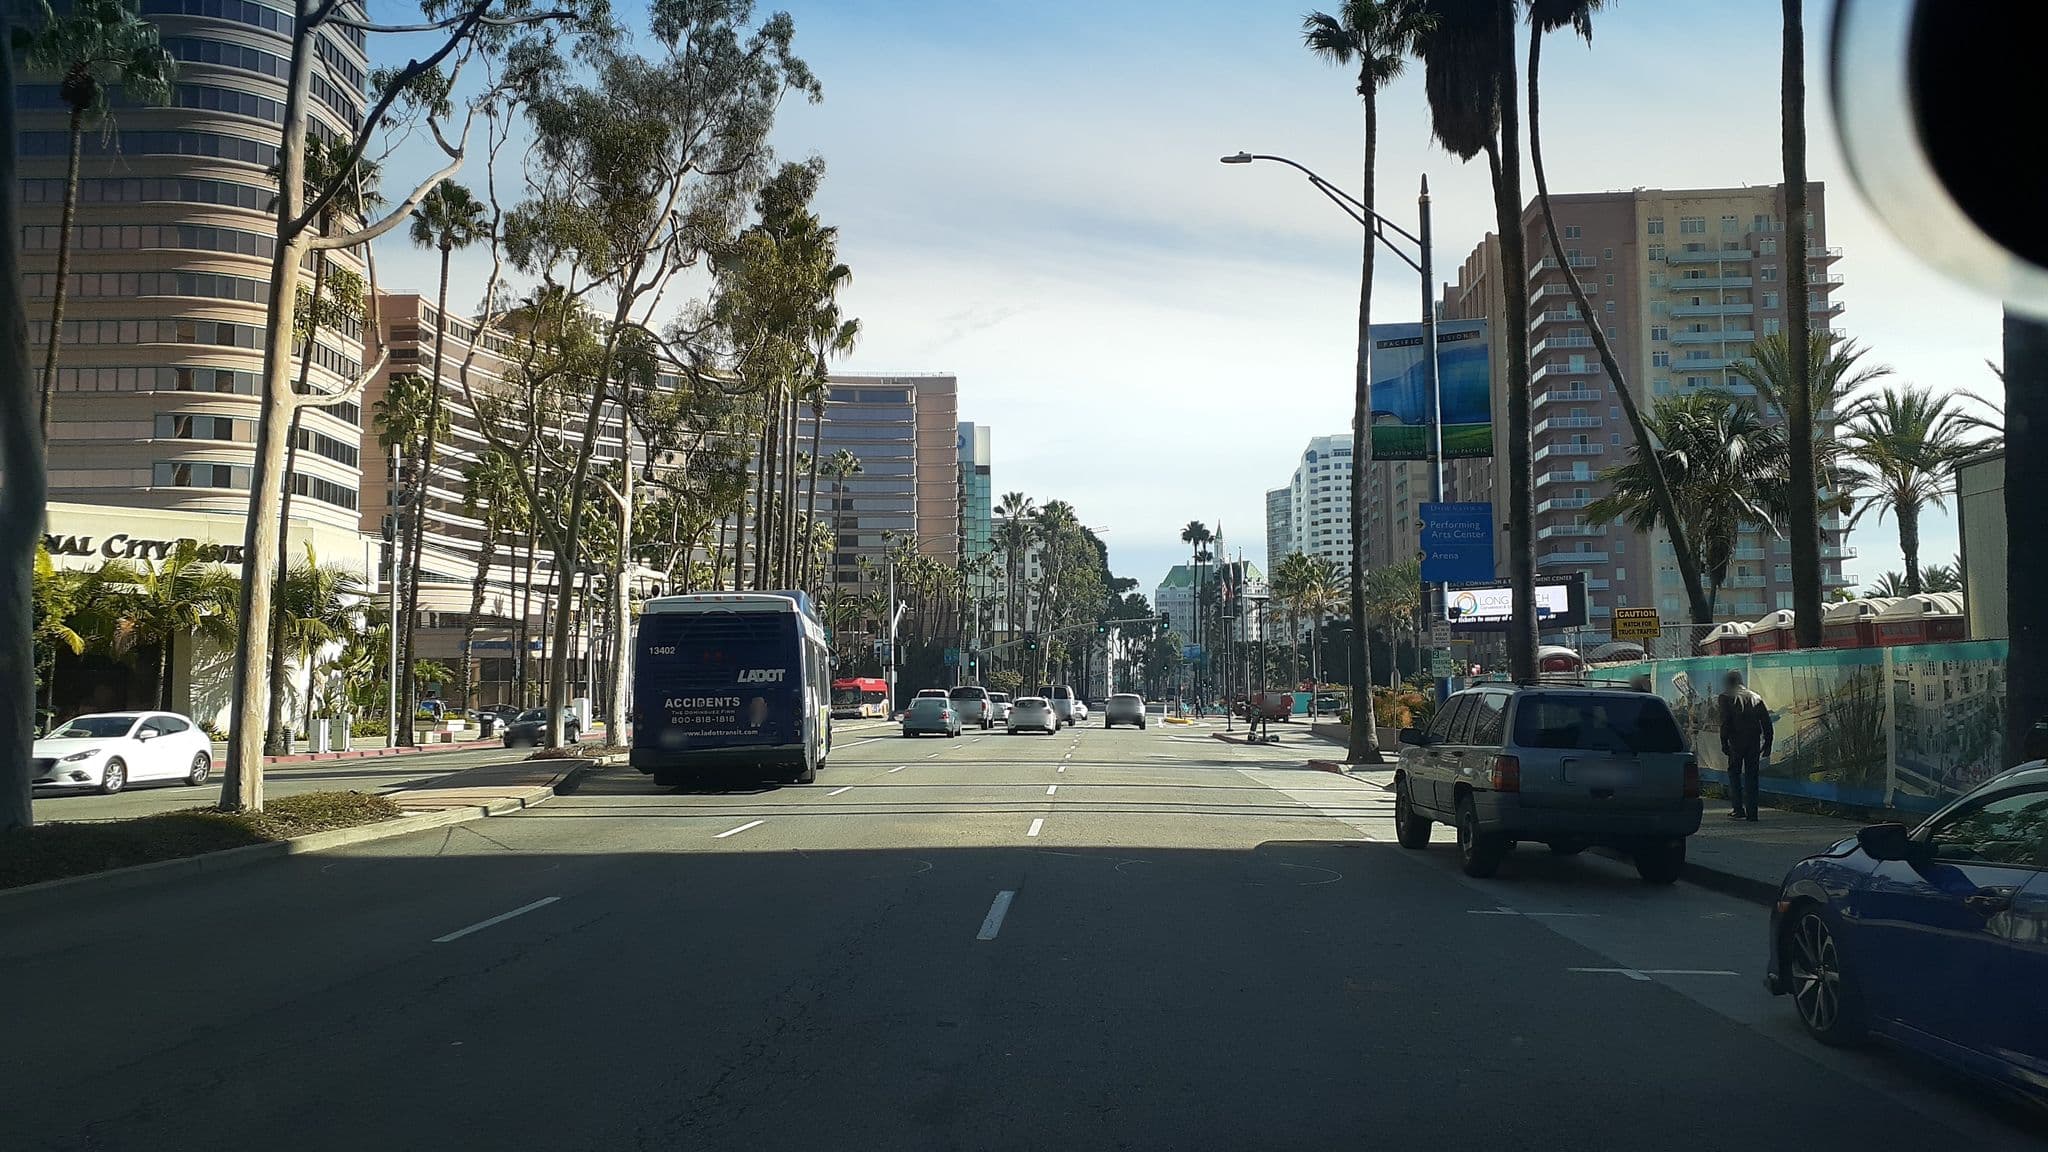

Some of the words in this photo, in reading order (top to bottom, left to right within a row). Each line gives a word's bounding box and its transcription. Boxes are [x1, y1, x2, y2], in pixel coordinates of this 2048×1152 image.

[1383, 338, 1420, 347] PACIFIC
[1441, 331, 1476, 342] ISIONS
[1430, 521, 1481, 530] Performing
[1453, 530, 1487, 538] Center
[101, 534, 176, 560] CITY
[1431, 552, 1459, 560] Arena
[1480, 595, 1509, 605] LONG
[1618, 610, 1655, 618] CAUTION
[649, 647, 676, 655] 13402
[737, 668, 786, 682] LADOT
[664, 697, 741, 708] ACCIDENTS
